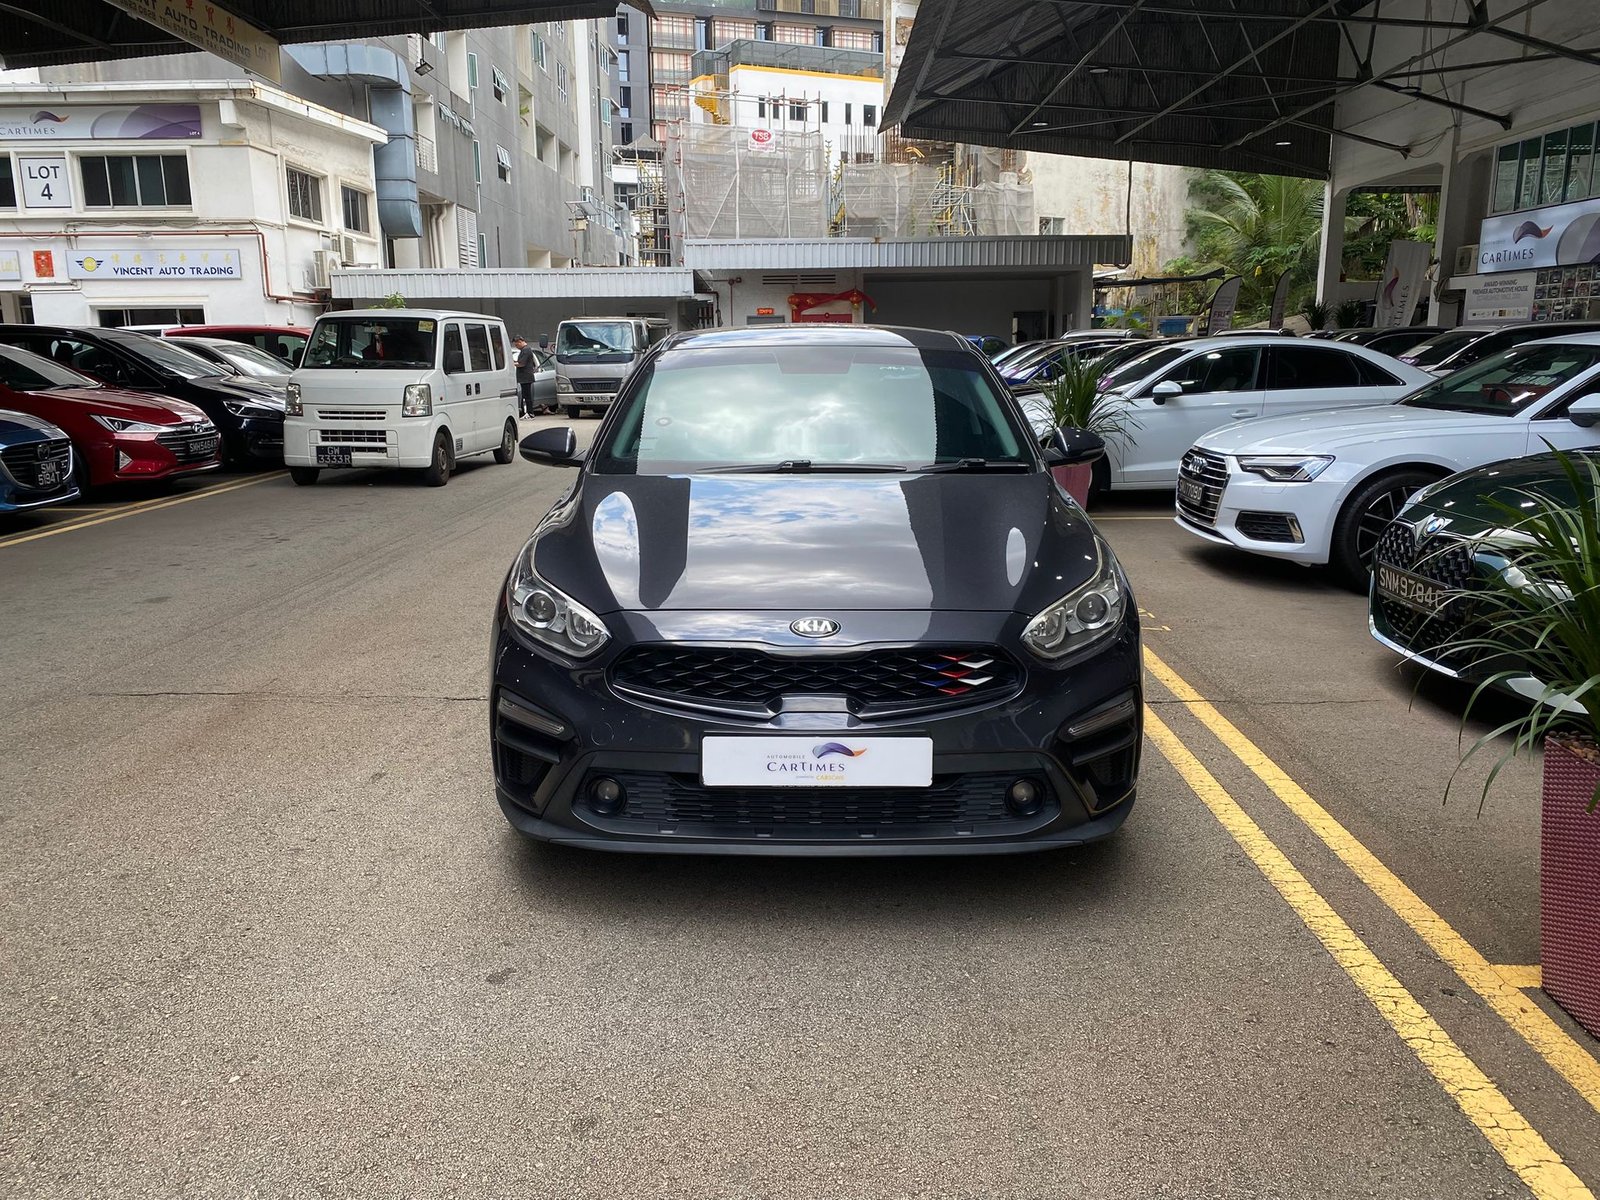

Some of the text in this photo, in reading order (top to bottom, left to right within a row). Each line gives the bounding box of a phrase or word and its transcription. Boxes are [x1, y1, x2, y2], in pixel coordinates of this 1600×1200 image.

[164, 6, 198, 31] AUTO
[202, 25, 251, 57] TRADING
[0, 126, 56, 136] CARTIMES
[28, 166, 60, 179] LOT
[41, 183, 53, 200] 4
[1481, 248, 1534, 264] CARTIMES
[112, 266, 234, 275] VINCENT AUTO TRADING
[327, 446, 340, 455] GW
[318, 454, 351, 465] 3333R
[798, 620, 833, 632] KIA
[767, 762, 845, 772] CARTIMES
